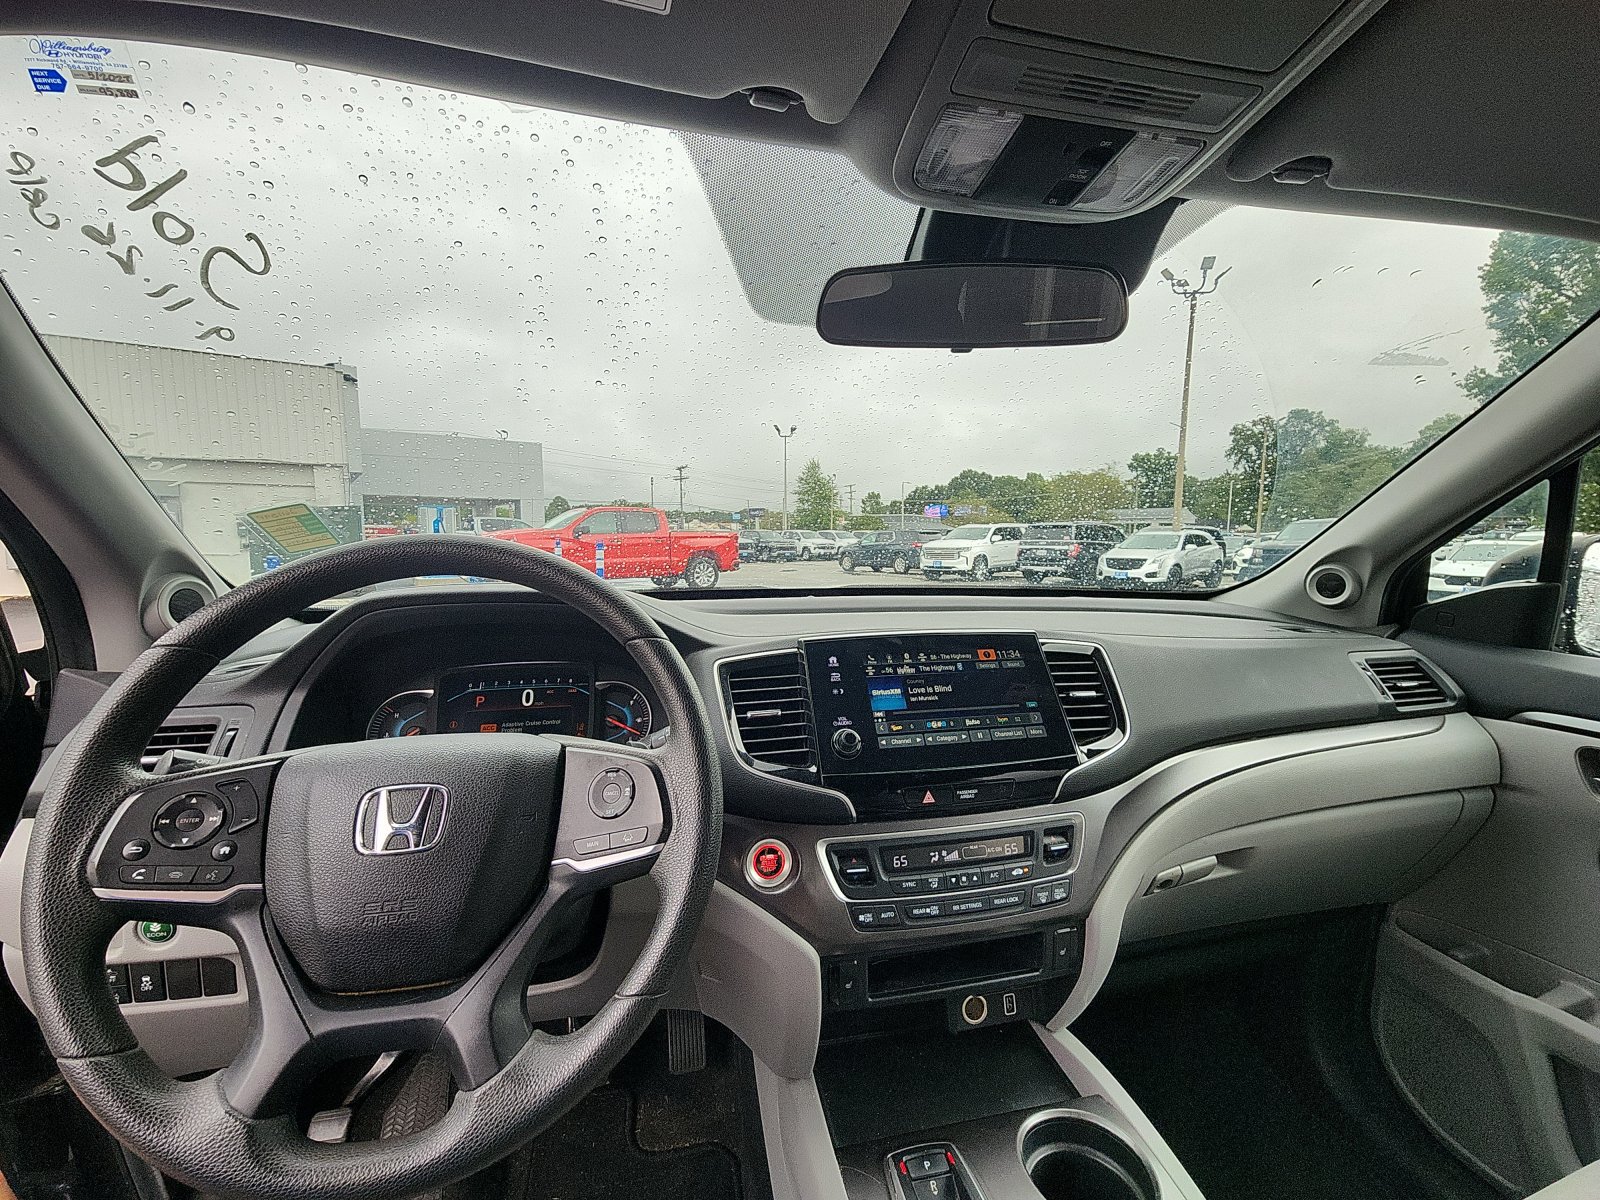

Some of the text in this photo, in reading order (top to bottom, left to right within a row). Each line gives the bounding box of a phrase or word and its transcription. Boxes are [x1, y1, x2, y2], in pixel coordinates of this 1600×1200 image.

[29, 38, 112, 55] Williamsburg
[997, 649, 1020, 659] 11:34
[931, 664, 955, 673] Highway
[872, 688, 901, 696] SiriusXM
[476, 696, 485, 707] P
[522, 689, 534, 707] 0
[936, 734, 958, 742] Category
[1004, 843, 1019, 855] 65
[893, 855, 908, 868] 65
[924, 1160, 931, 1171] P
[929, 1180, 938, 1192] R
